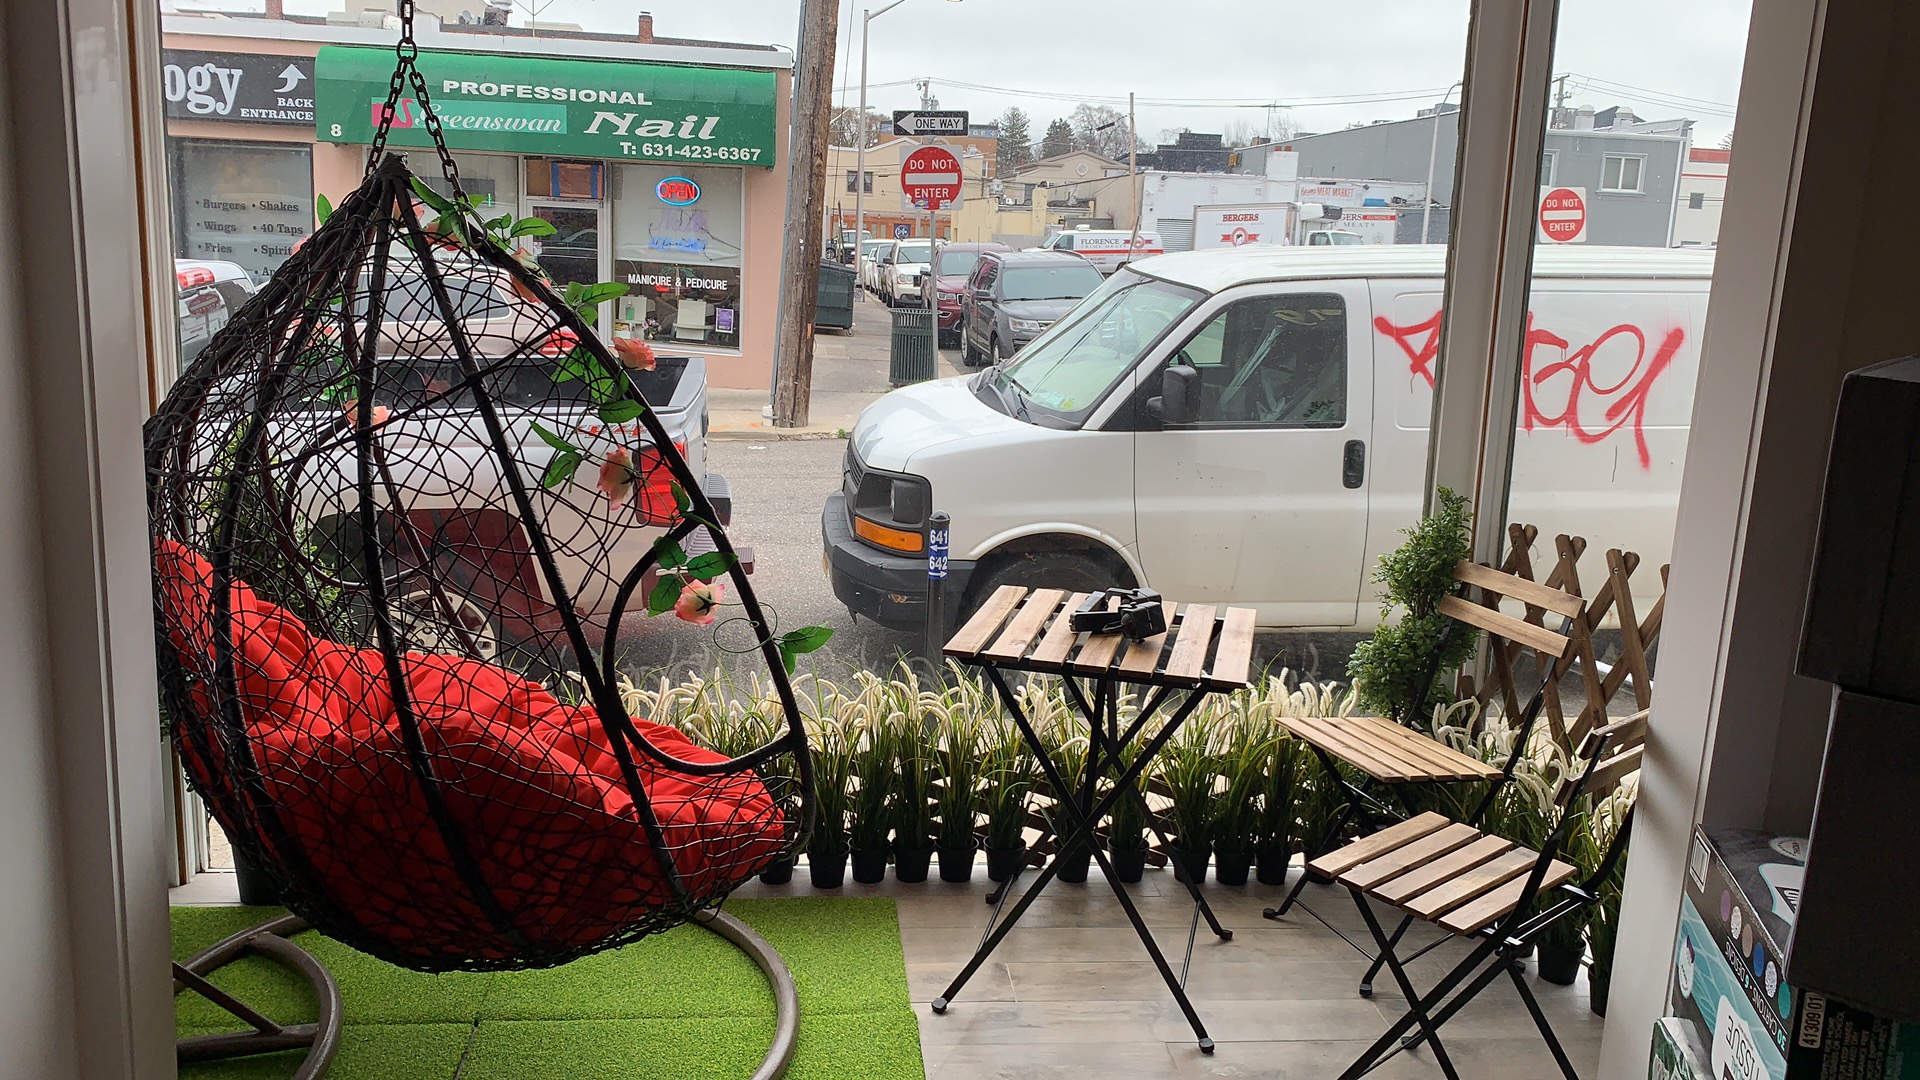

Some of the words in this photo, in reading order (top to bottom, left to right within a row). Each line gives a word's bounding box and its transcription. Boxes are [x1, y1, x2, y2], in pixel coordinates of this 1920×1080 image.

[443, 80, 653, 105] PROFESSIONAL
[277, 97, 314, 108] BACK
[240, 108, 314, 121] ENTRANCE
[330, 123, 342, 137] 8
[583, 111, 721, 140] Nail
[915, 118, 936, 129] ONE
[939, 118, 960, 129] WAY
[619, 141, 637, 155] T:
[642, 142, 761, 161] 631-423-6367
[909, 159, 925, 170] DO
[931, 159, 953, 170] NOT
[659, 182, 696, 199] OPEN
[914, 188, 949, 198] ENTER
[1316, 187, 1332, 197] MEAT
[1332, 187, 1354, 198] MARKET
[203, 199, 246, 212] Burgers
[259, 200, 299, 212] Shakes
[1546, 199, 1558, 208] DO
[1562, 198, 1579, 208] NOT
[1222, 213, 1259, 222] BERGERS
[1341, 213, 1362, 221] GERS
[204, 220, 237, 234] Wings
[260, 223, 274, 233] 40
[277, 223, 304, 236] Taps
[1549, 222, 1576, 232] ENTER
[205, 242, 233, 254] Fries
[261, 244, 293, 257] Spirit
[628, 273, 672, 287] MANICURE
[675, 276, 682, 287] &
[686, 277, 728, 291] PEDICURE
[930, 529, 948, 544] 641
[929, 555, 948, 571] 642
[1724, 941, 1746, 983] DESIGNS
[1751, 986, 1778, 1036] CARTONS
[1801, 1012, 1822, 1047] 41309
[1777, 1028, 1787, 1052] 30
